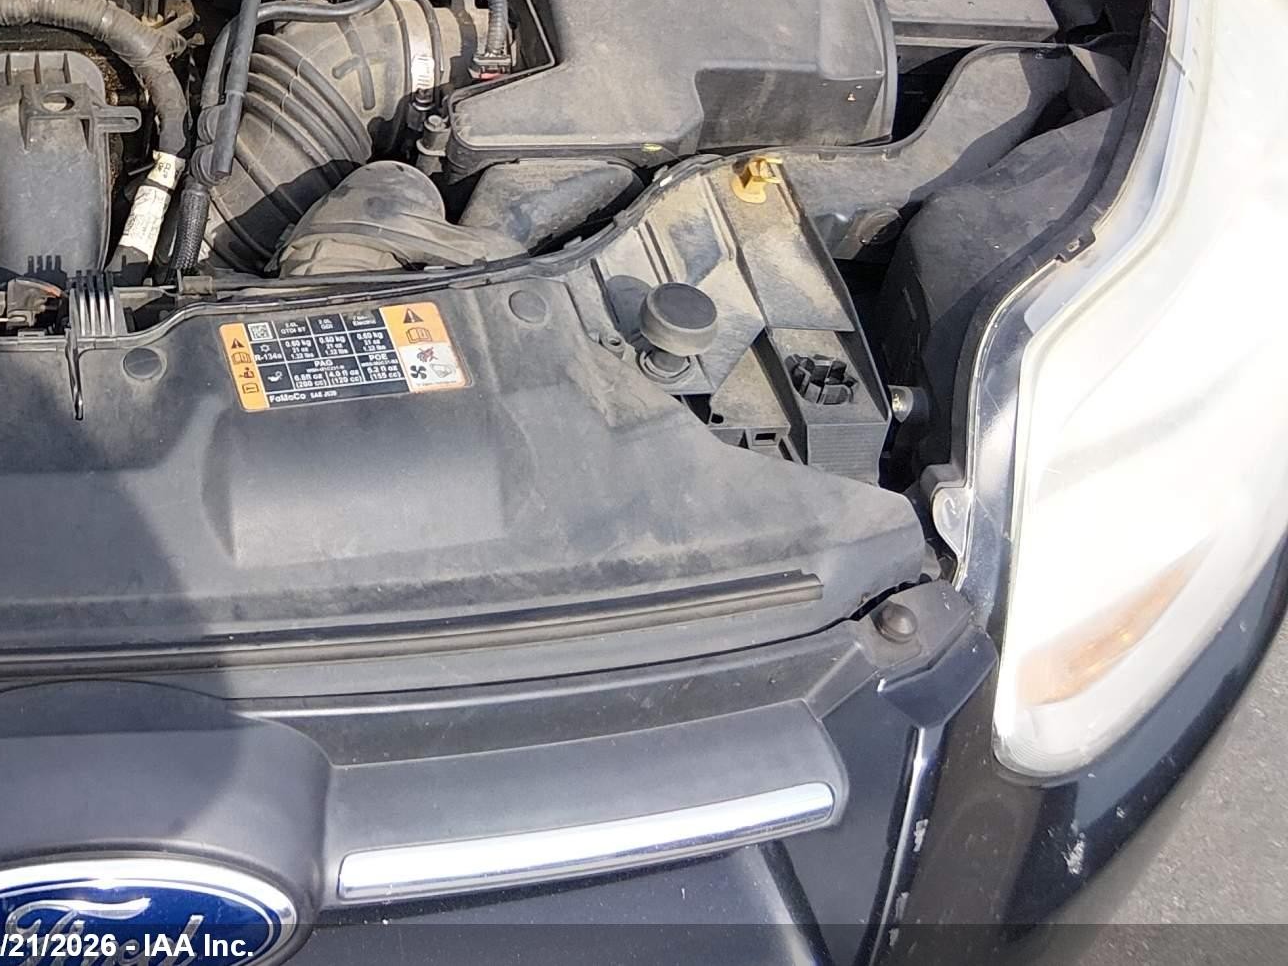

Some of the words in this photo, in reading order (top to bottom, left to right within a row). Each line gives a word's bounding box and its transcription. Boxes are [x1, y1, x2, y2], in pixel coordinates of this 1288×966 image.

[318, 336, 335, 344] 0.60
[335, 335, 347, 343] kg
[356, 332, 372, 340] 0.60
[372, 331, 384, 339] kg
[284, 338, 301, 348] 0.60
[301, 338, 312, 347] kg
[254, 352, 283, 362] R-134a
[368, 353, 388, 361] POE
[314, 359, 334, 367] PAG
[328, 370, 341, 378] 4.0
[388, 371, 401, 379] cc)
[314, 379, 327, 387] cc)
[331, 376, 348, 384] (120
[349, 375, 362, 383] cc)
[269, 392, 307, 403] FoMoCo
